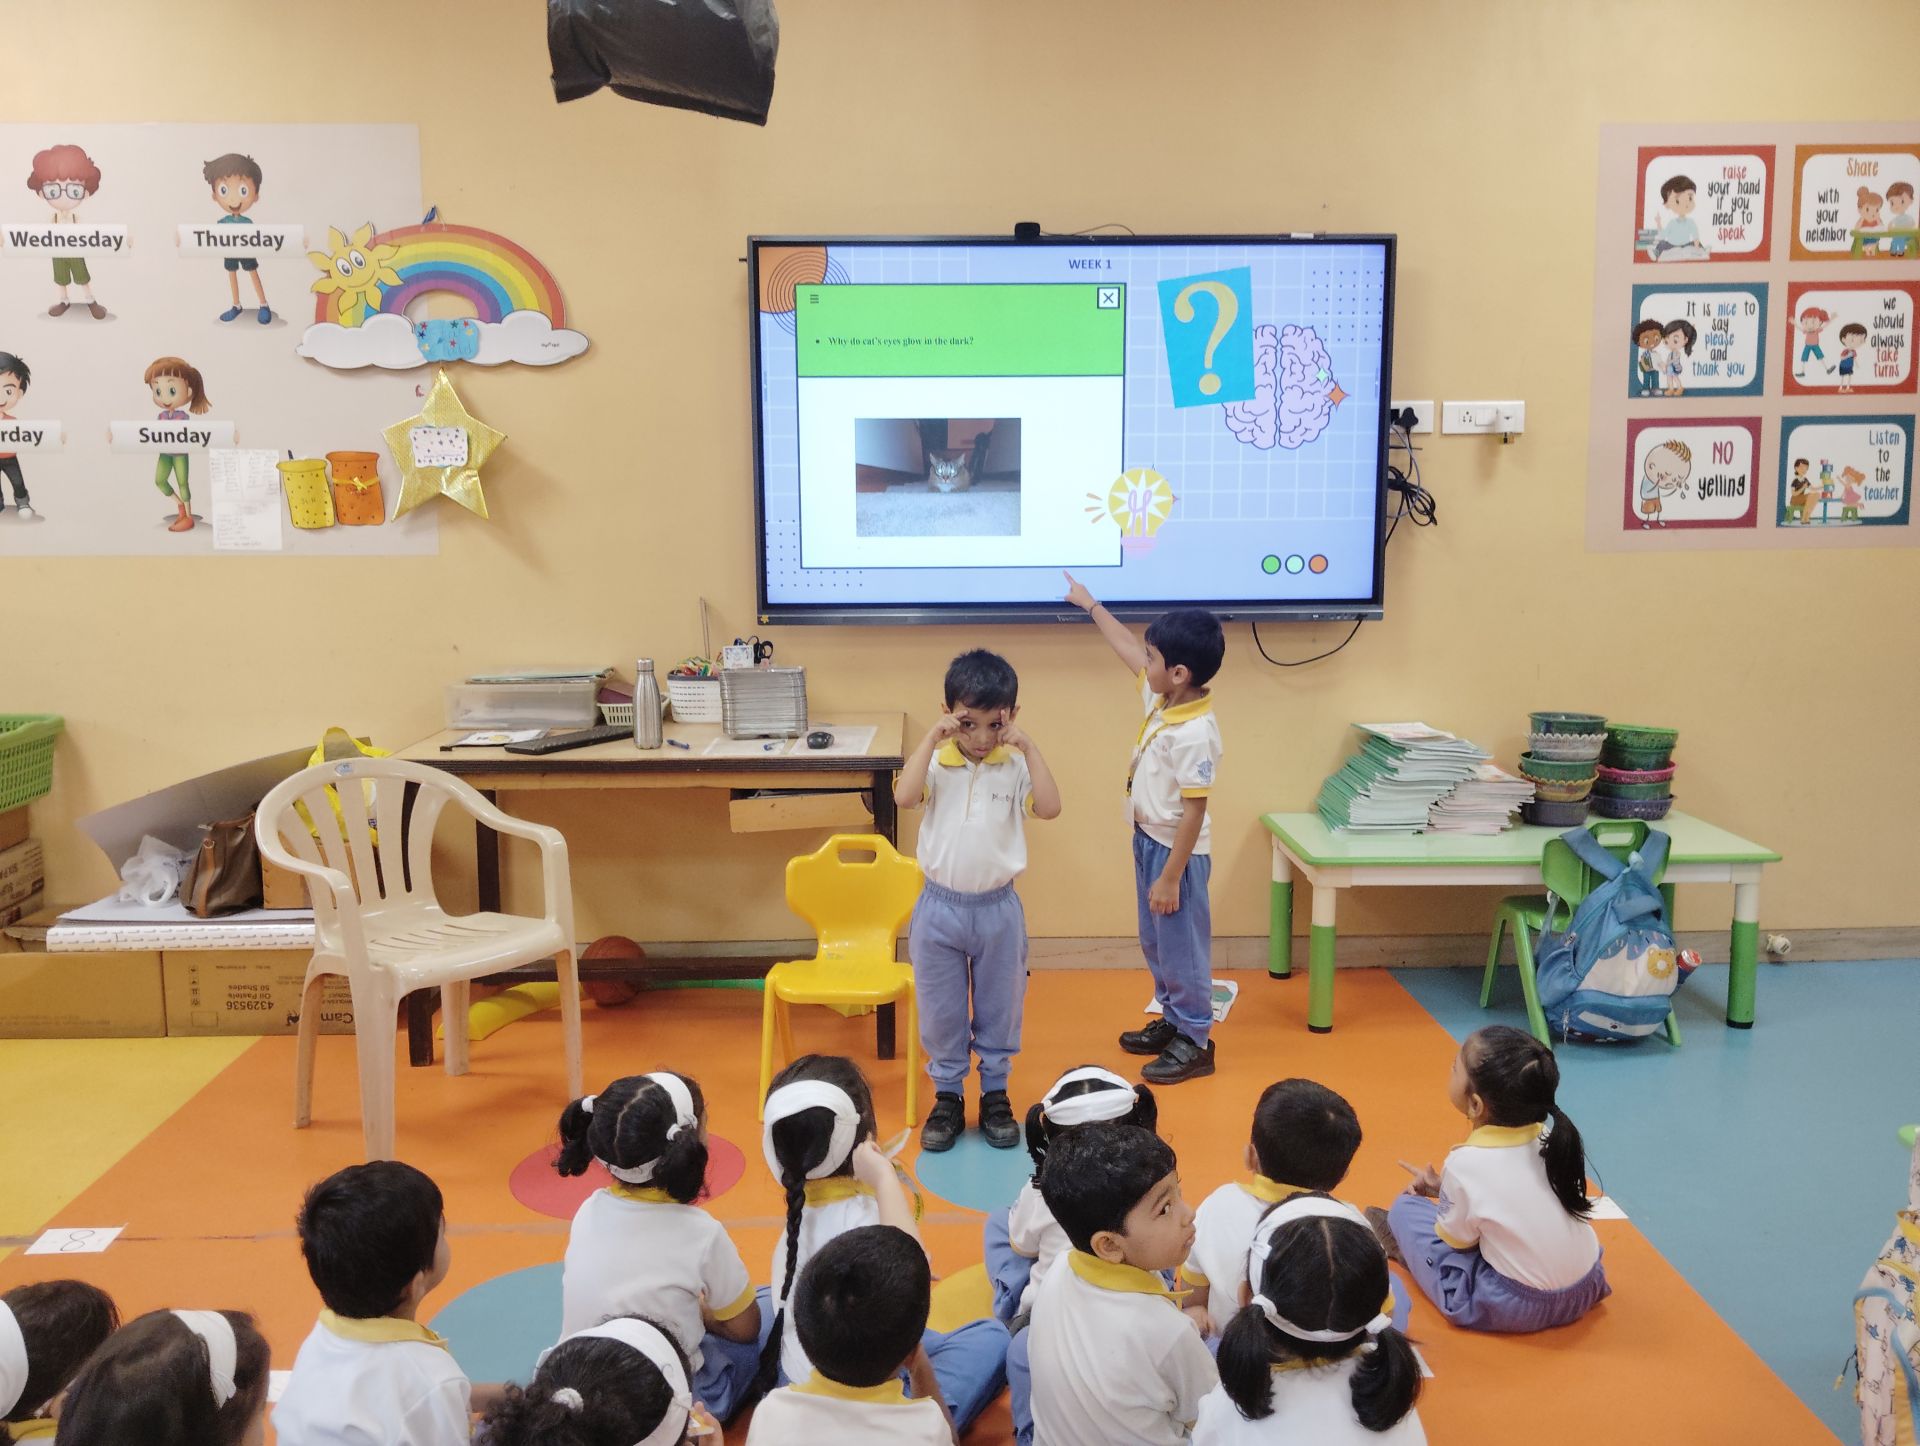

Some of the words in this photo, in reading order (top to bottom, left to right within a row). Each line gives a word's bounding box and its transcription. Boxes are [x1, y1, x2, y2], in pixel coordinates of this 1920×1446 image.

[1723, 165, 1747, 180] raise
[1847, 157, 1879, 177] Share
[1707, 181, 1730, 198] your
[1737, 178, 1760, 195] hand
[1817, 187, 1840, 204] with
[1716, 196, 1724, 210] if
[1731, 196, 1750, 212] you
[1712, 208, 1734, 226] need
[1741, 209, 1753, 225] to
[1816, 209, 1839, 225] your
[9, 230, 124, 251] Wednesday
[193, 230, 285, 251] Thursday
[1718, 225, 1746, 244] speak
[1806, 227, 1847, 243] neighbor
[1068, 259, 1102, 270] WEEK
[1106, 259, 1113, 270] 1
[1687, 301, 1697, 317] It
[1703, 302, 1711, 317] is
[1718, 301, 1737, 317] nice
[1744, 300, 1756, 316] to
[1712, 318, 1729, 334] say
[1873, 313, 1905, 330] should
[828, 336, 848, 346] Why
[850, 336, 861, 345] do
[862, 336, 882, 345] cat's
[883, 338, 901, 347] eyes
[902, 336, 922, 347] glow
[924, 336, 933, 345] in
[935, 336, 948, 345] the
[949, 336, 974, 345] dark?
[1705, 331, 1735, 350] please
[1871, 333, 1905, 350] always
[1710, 345, 1728, 361] and
[1876, 347, 1899, 363] take
[1693, 361, 1720, 377] thank
[1727, 361, 1745, 378] you
[1874, 363, 1900, 378] turns
[139, 427, 212, 447] Sunday
[1869, 429, 1900, 446] Listen
[1712, 440, 1734, 466] NO
[1878, 447, 1890, 464] to
[1875, 466, 1891, 483] the
[1697, 473, 1746, 501] yelling
[1864, 485, 1900, 501] teacher
[226, 1001, 275, 1011] 4329536
[320, 1012, 354, 1025] Cam
